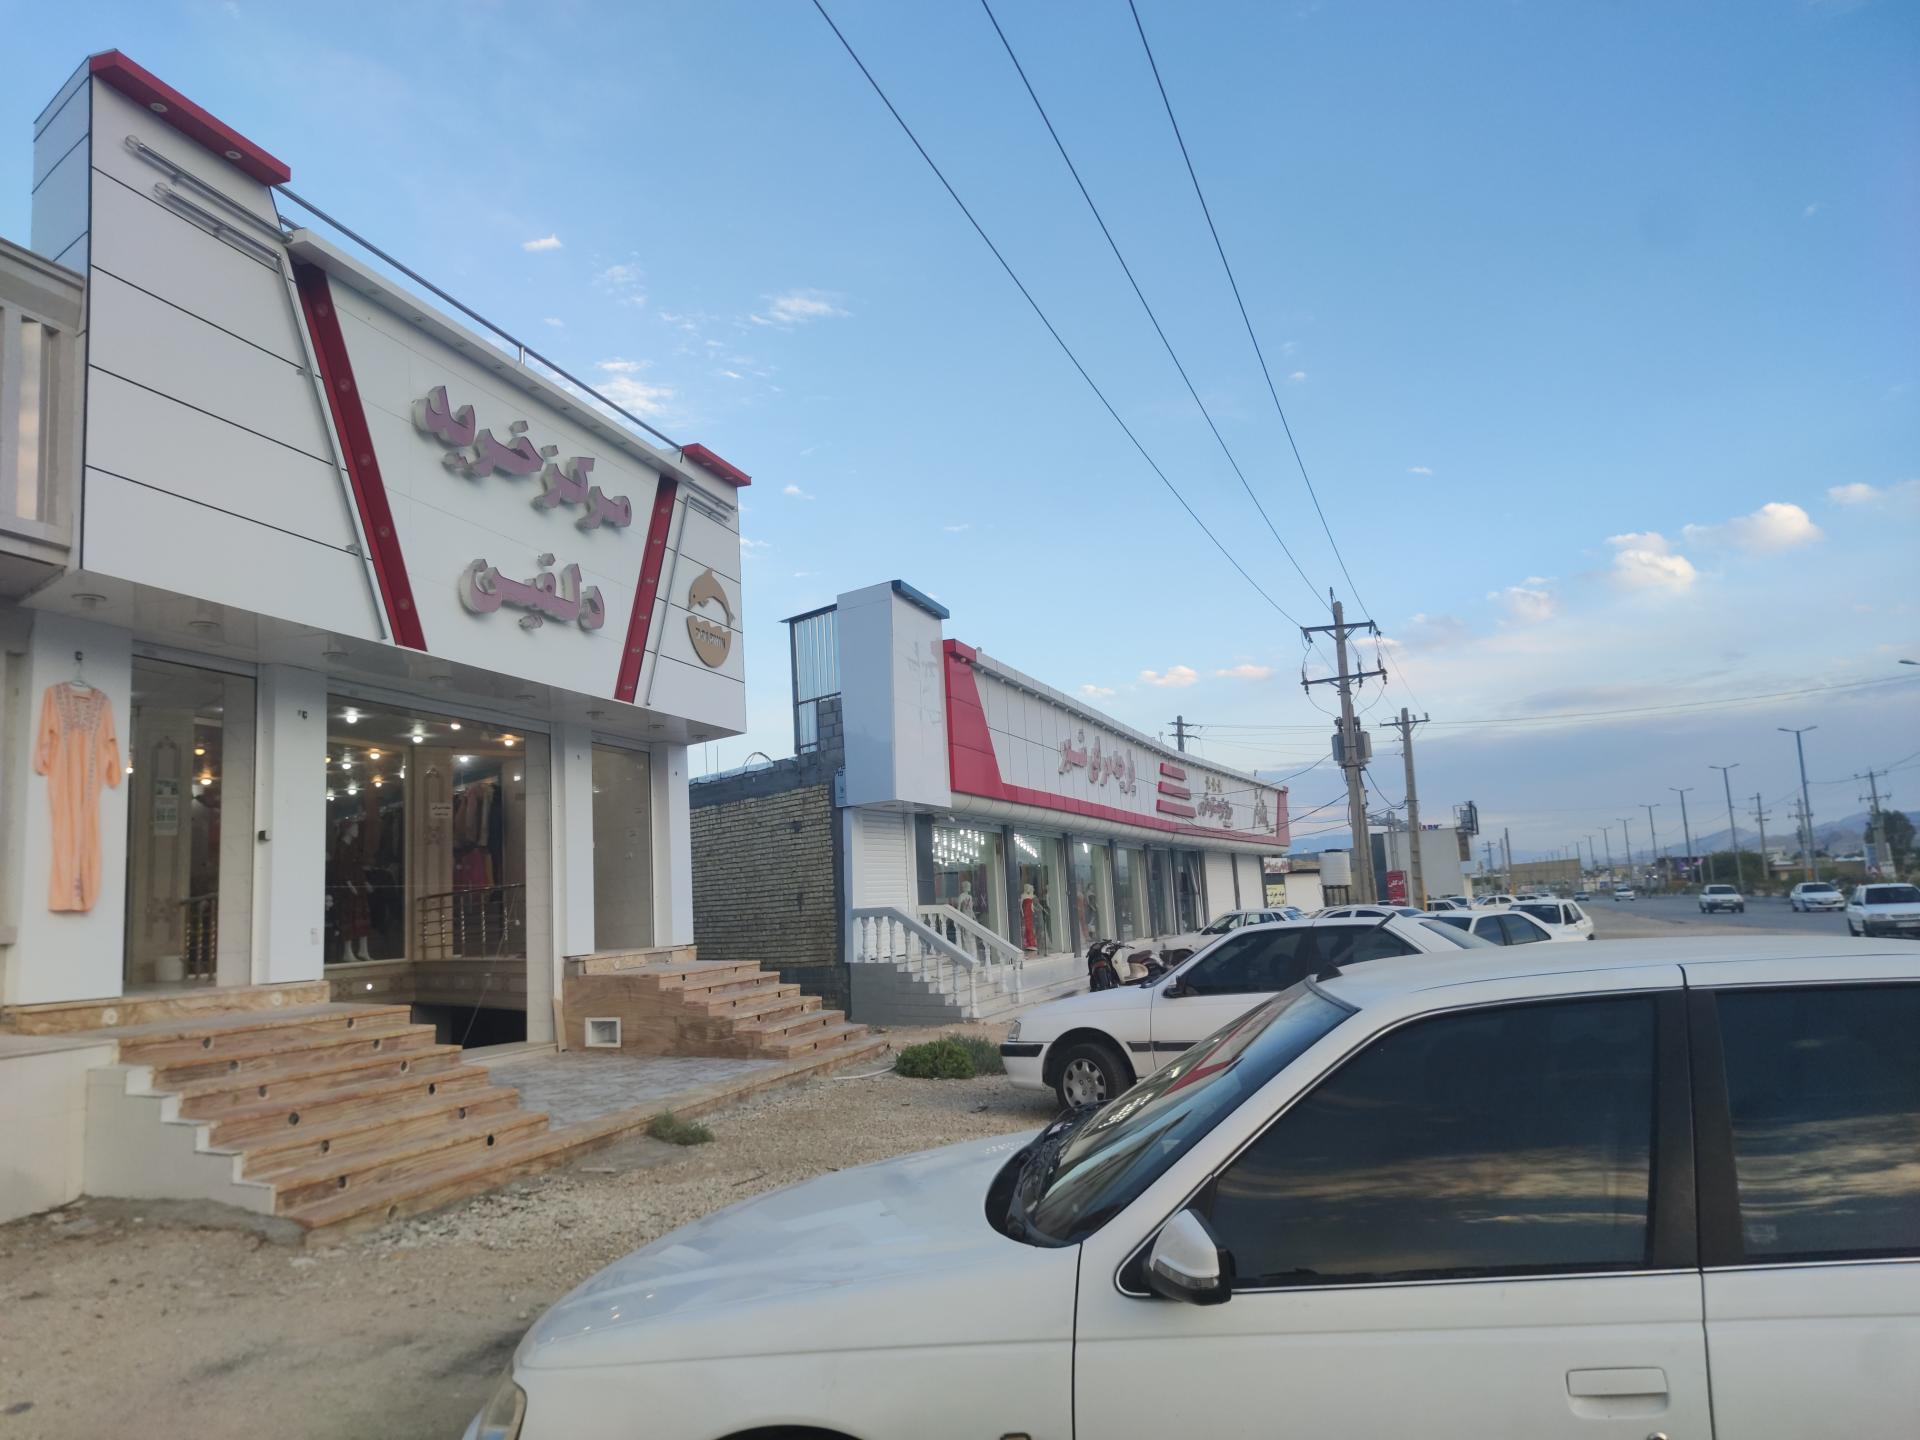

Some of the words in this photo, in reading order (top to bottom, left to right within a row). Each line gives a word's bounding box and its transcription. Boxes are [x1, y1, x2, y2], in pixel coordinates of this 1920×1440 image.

[412, 385, 544, 479] خرید
[531, 445, 632, 531] مرکز
[459, 553, 605, 631] دلفین
